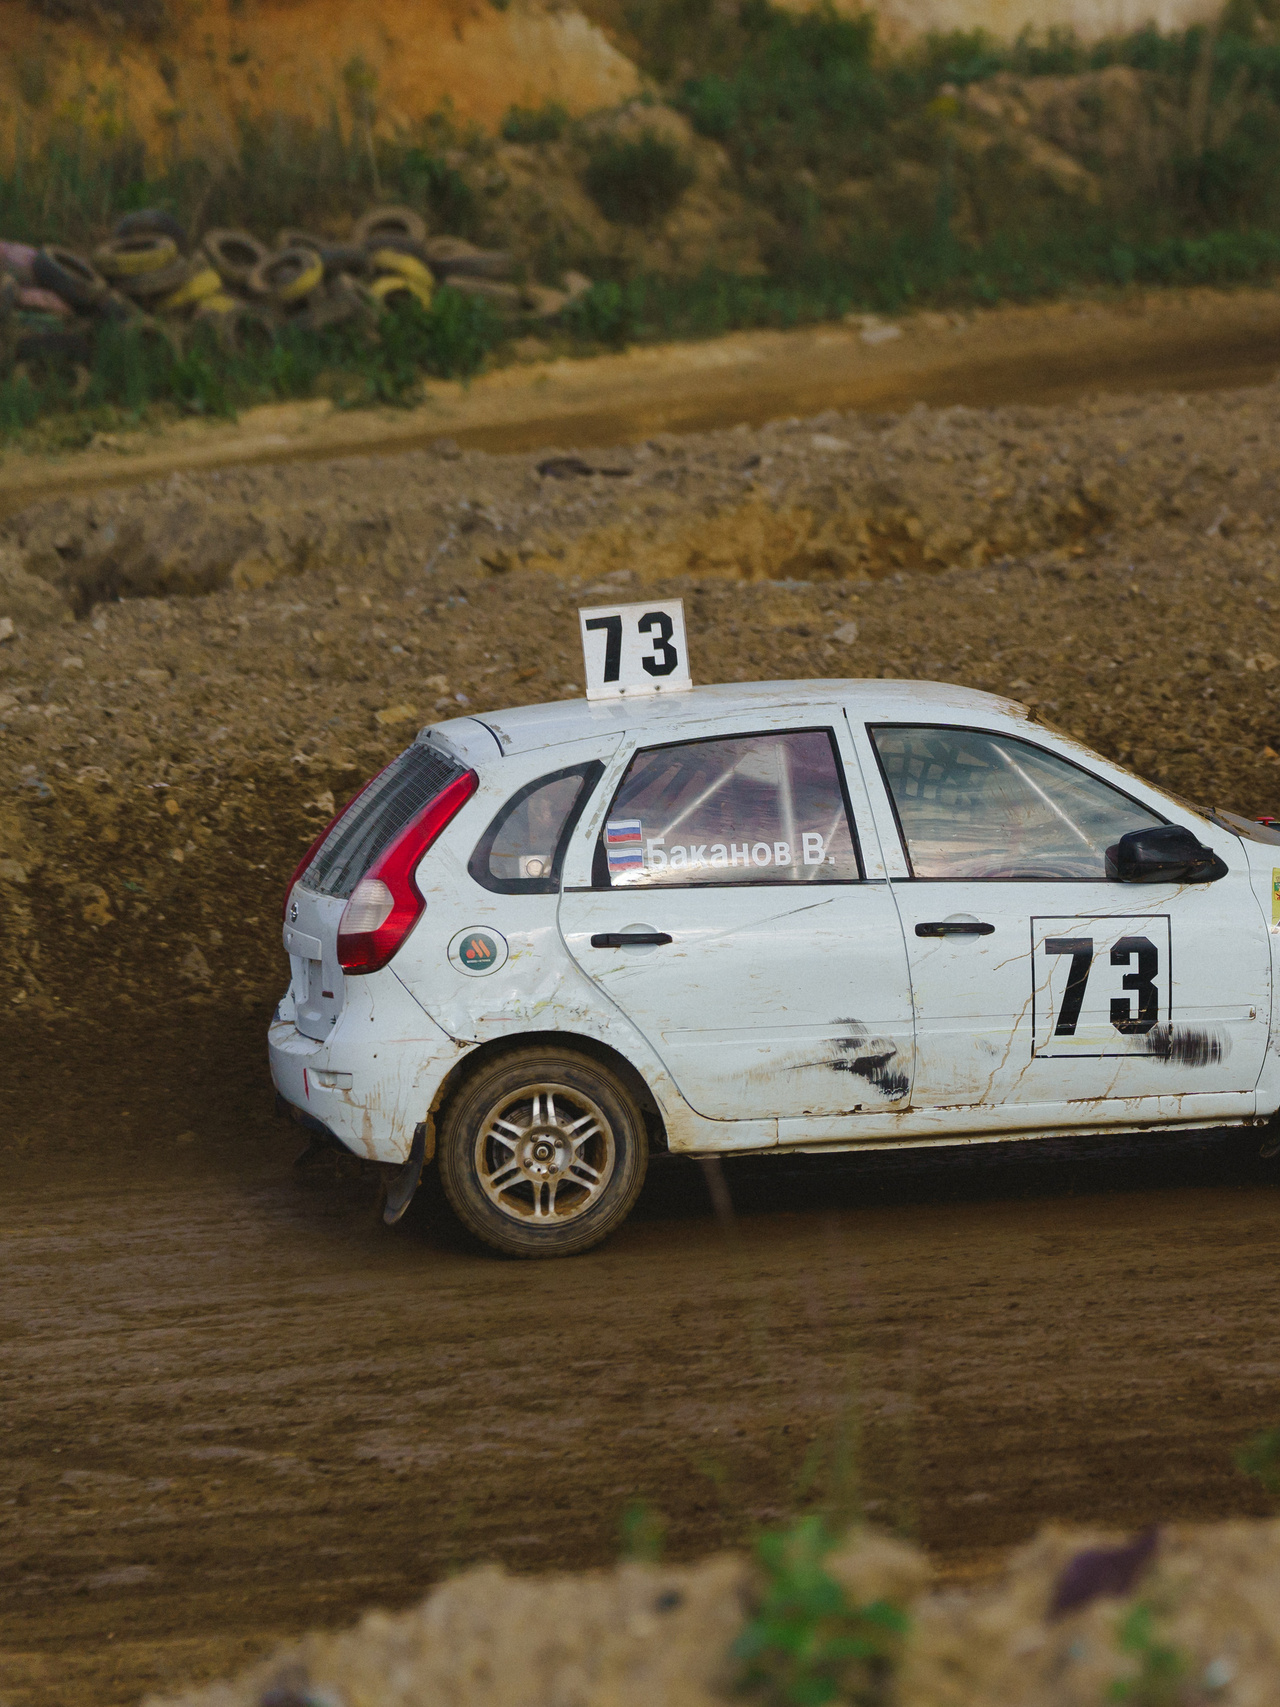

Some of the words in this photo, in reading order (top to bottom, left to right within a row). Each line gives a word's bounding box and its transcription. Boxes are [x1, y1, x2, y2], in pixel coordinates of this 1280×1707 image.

[585, 611, 678, 683] 73
[646, 837, 792, 870] Баканов
[802, 832, 836, 865] В.
[1045, 936, 1159, 1036] 73
